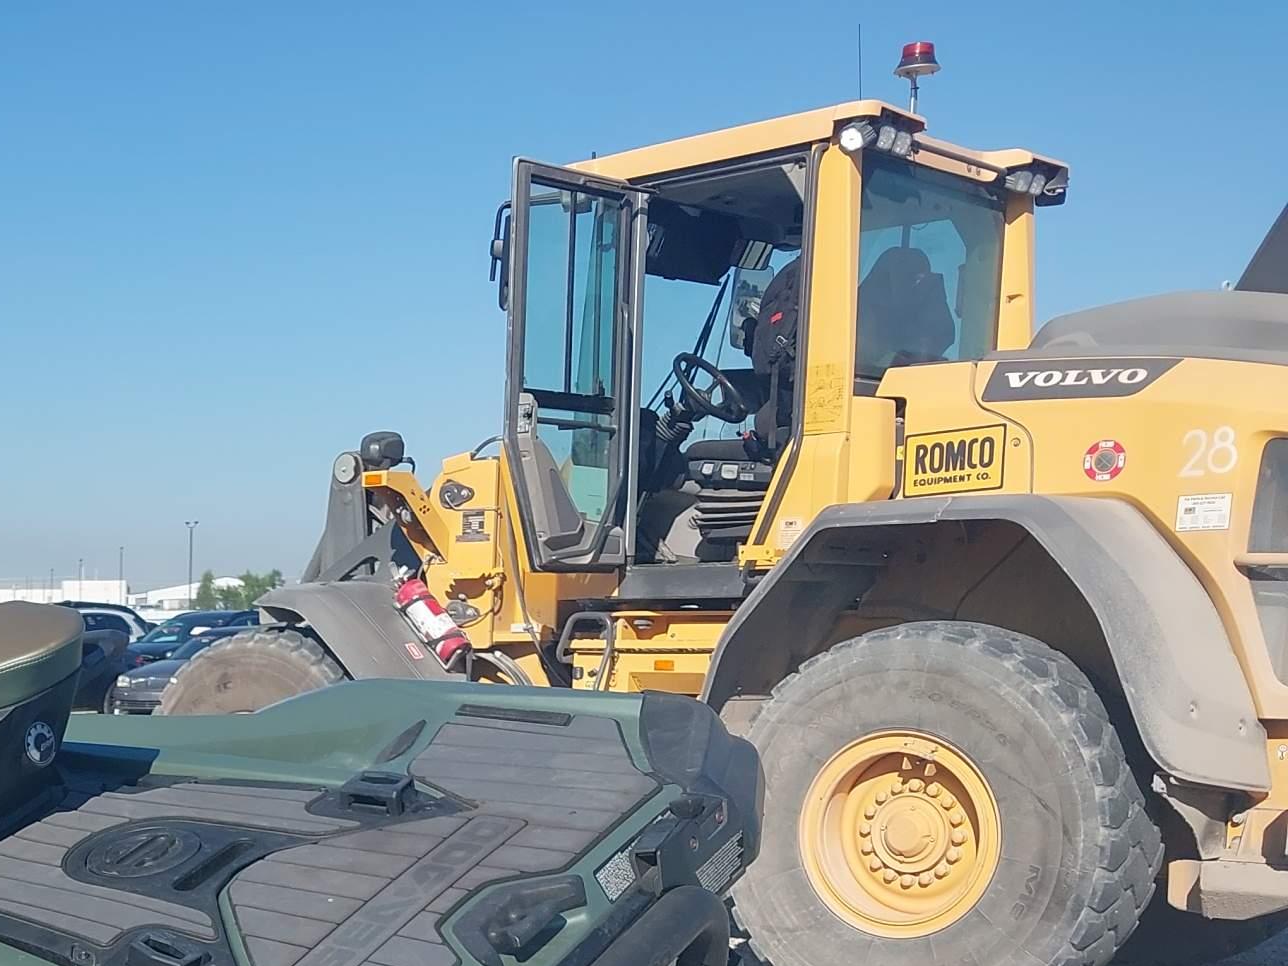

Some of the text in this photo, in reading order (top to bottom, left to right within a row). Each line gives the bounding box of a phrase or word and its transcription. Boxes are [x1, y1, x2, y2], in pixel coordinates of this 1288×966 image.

[1004, 368, 1148, 388] VOLVO
[914, 436, 995, 475] ROMCO
[1176, 425, 1238, 477] 28
[913, 472, 992, 487] EQUIPMENT CO.
